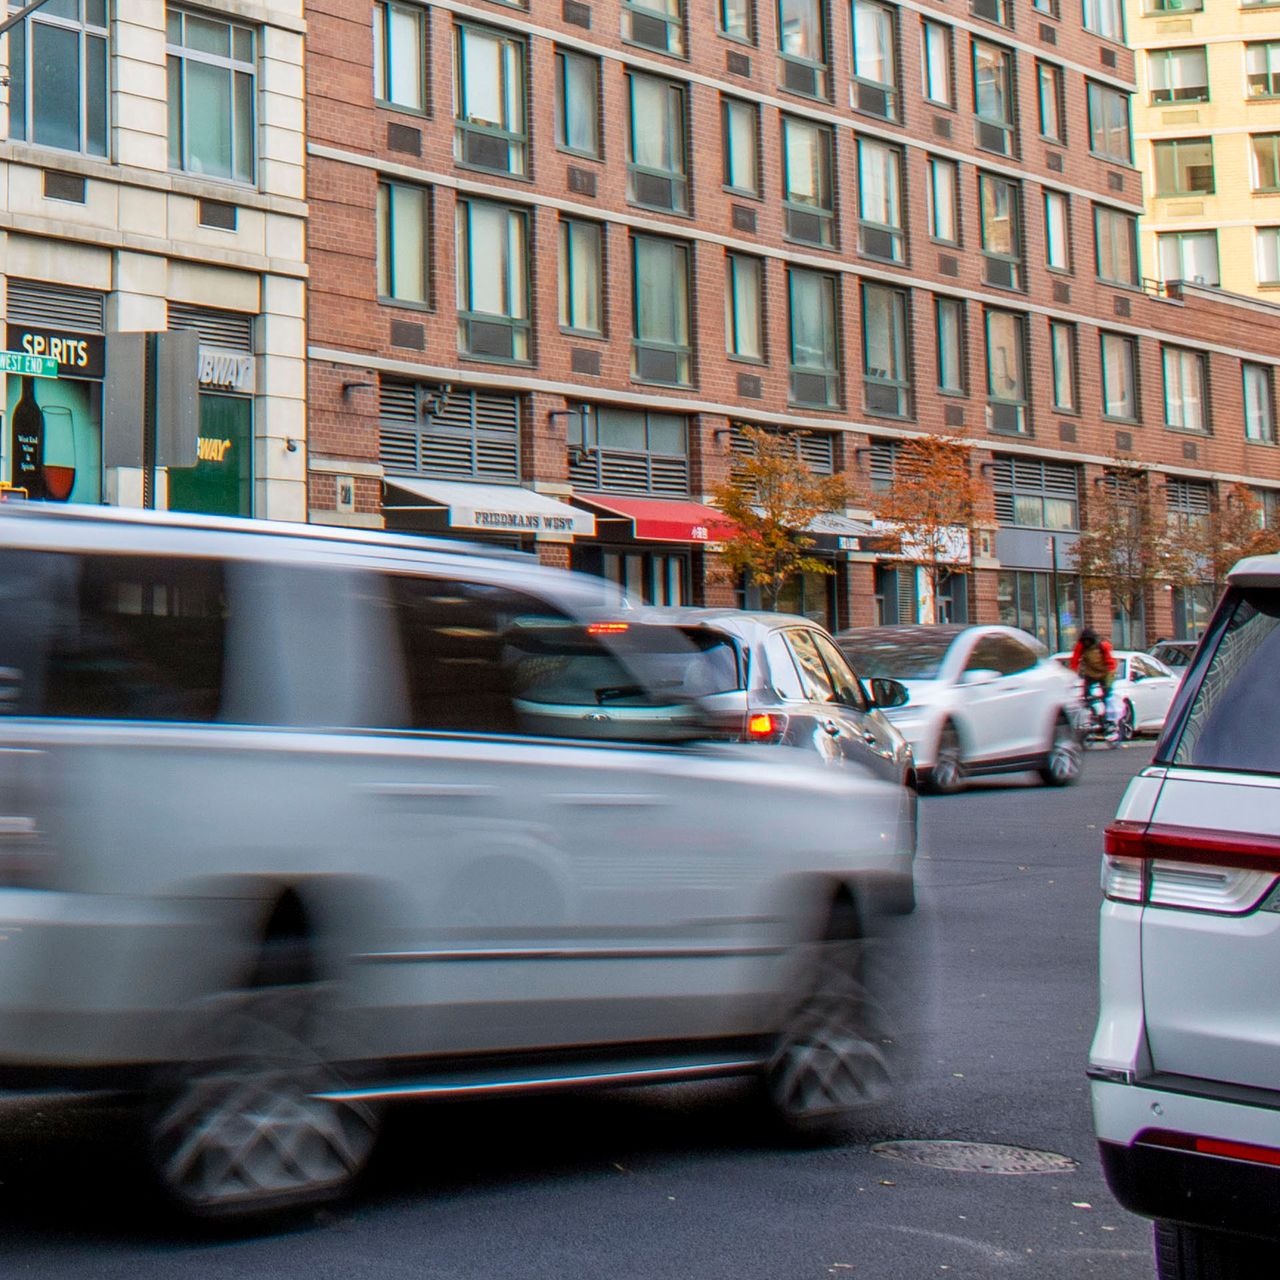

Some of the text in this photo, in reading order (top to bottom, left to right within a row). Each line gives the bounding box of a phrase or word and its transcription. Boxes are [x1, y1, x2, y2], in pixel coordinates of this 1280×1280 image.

[22, 333, 88, 367] SPIRITS
[0, 353, 22, 370] WEST
[25, 357, 43, 373] END
[197, 437, 231, 462] WAY
[474, 511, 574, 531] FRIEDMANS WEST
